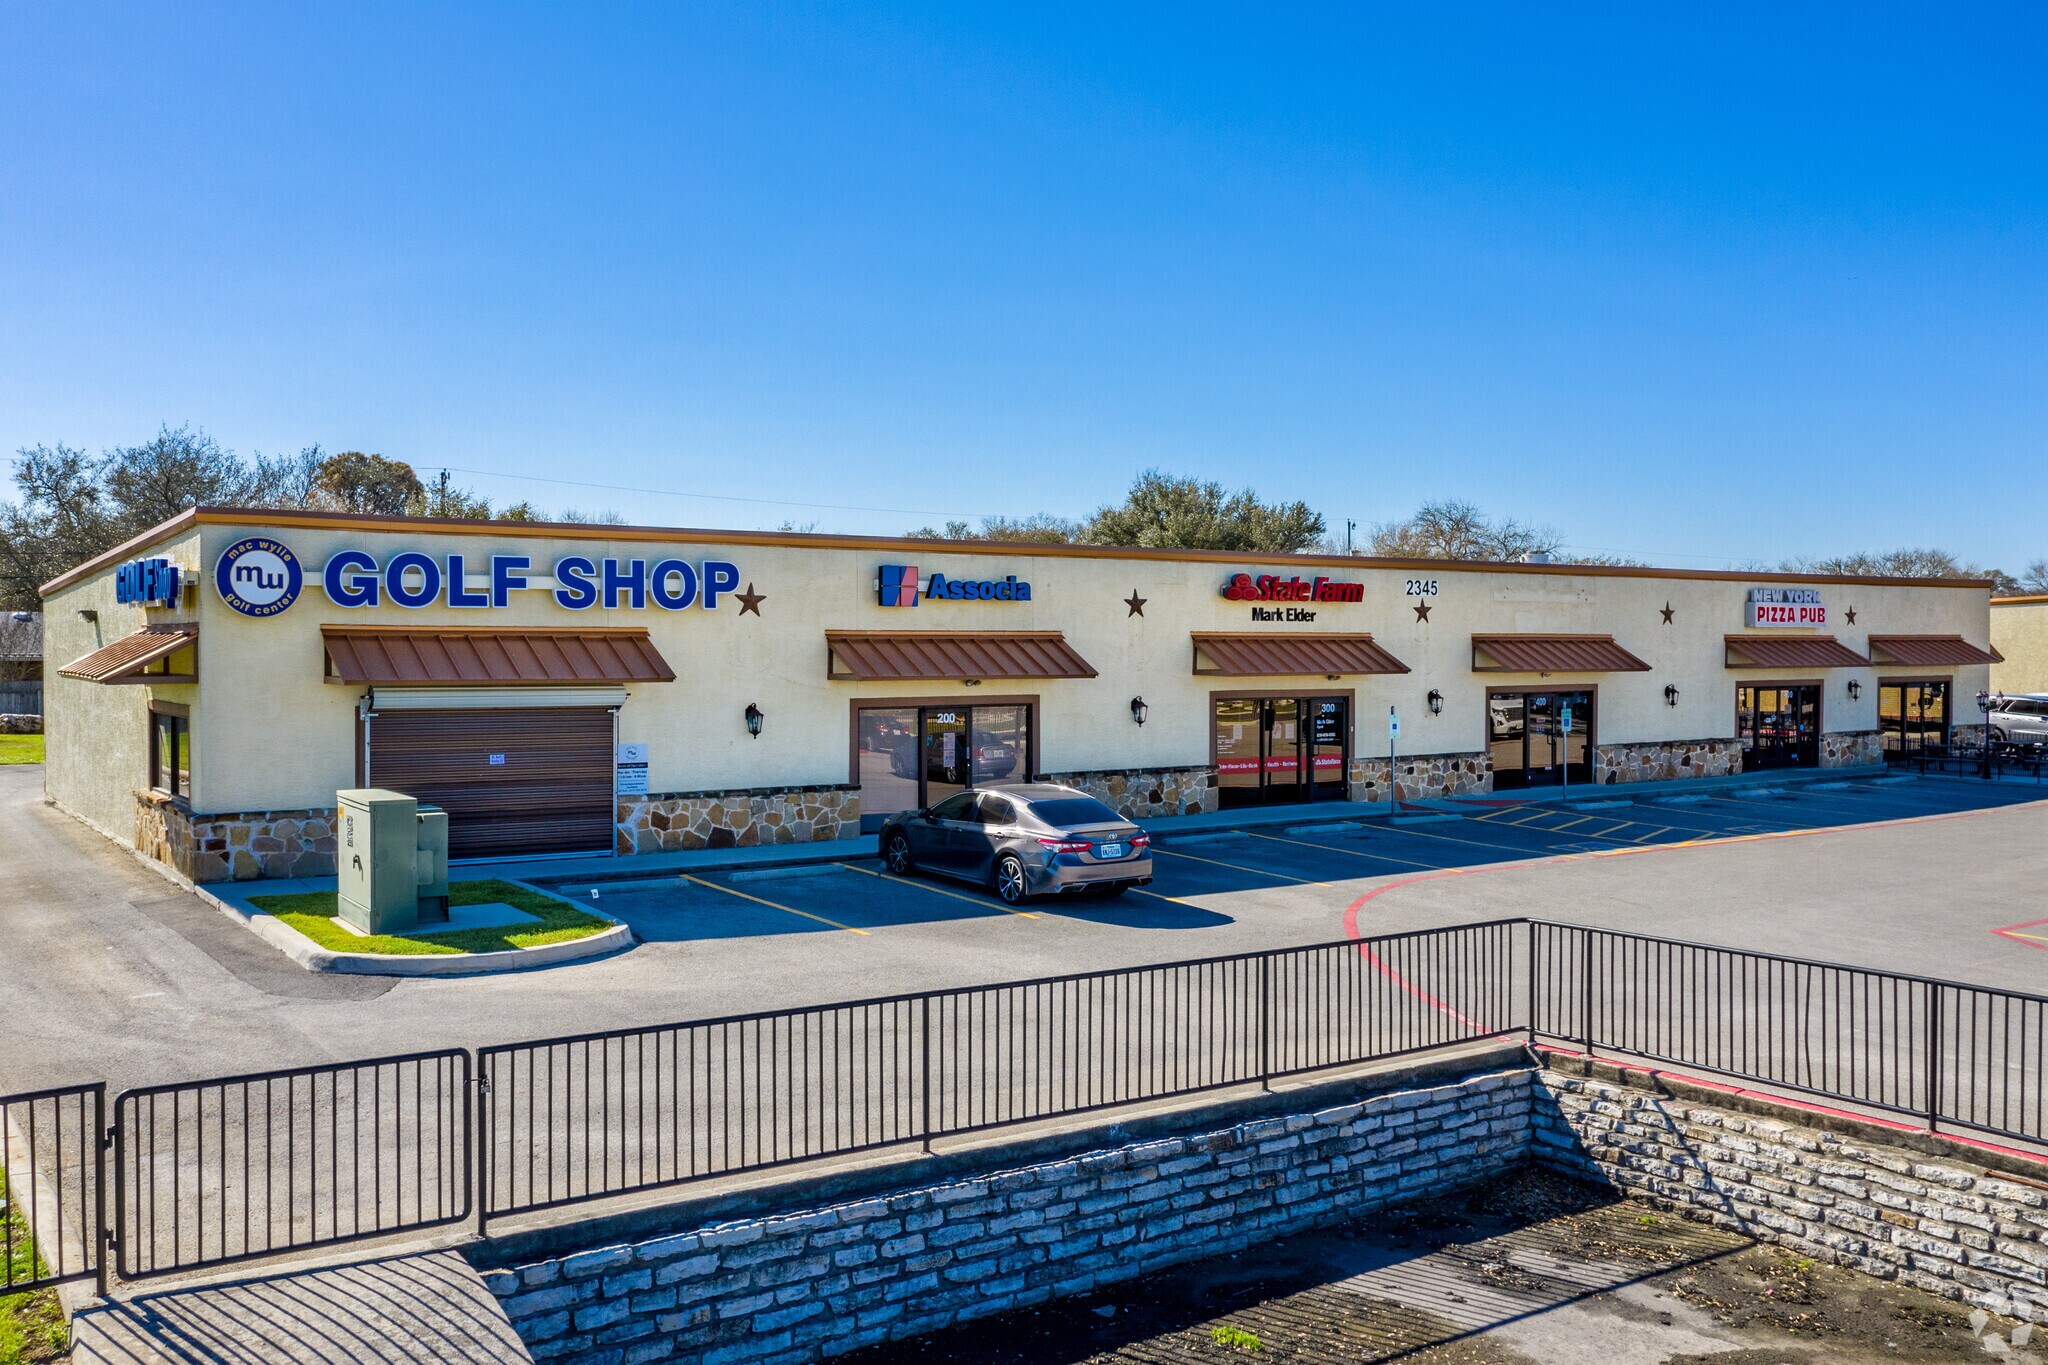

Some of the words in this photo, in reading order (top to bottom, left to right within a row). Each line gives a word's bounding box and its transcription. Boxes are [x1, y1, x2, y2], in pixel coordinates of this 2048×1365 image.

[228, 541, 253, 560] mac
[258, 540, 292, 562] wylie
[116, 559, 154, 604] GOLF
[323, 550, 531, 609] GOLF
[553, 556, 741, 611] SHOP
[925, 573, 1031, 601] Associa
[1256, 574, 1311, 602] State
[1310, 576, 1364, 603] Farm
[1406, 579, 1438, 596] 2345
[224, 590, 250, 613] golf
[254, 592, 294, 615] center
[1752, 588, 1783, 602] NEW
[1786, 589, 1822, 603] YORK
[1251, 607, 1284, 622] Mark
[1286, 608, 1317, 622] Elder
[1757, 606, 1796, 623] PIZZA
[1800, 607, 1826, 623] PUB
[1321, 703, 1336, 713] 300
[936, 712, 956, 724] 200
